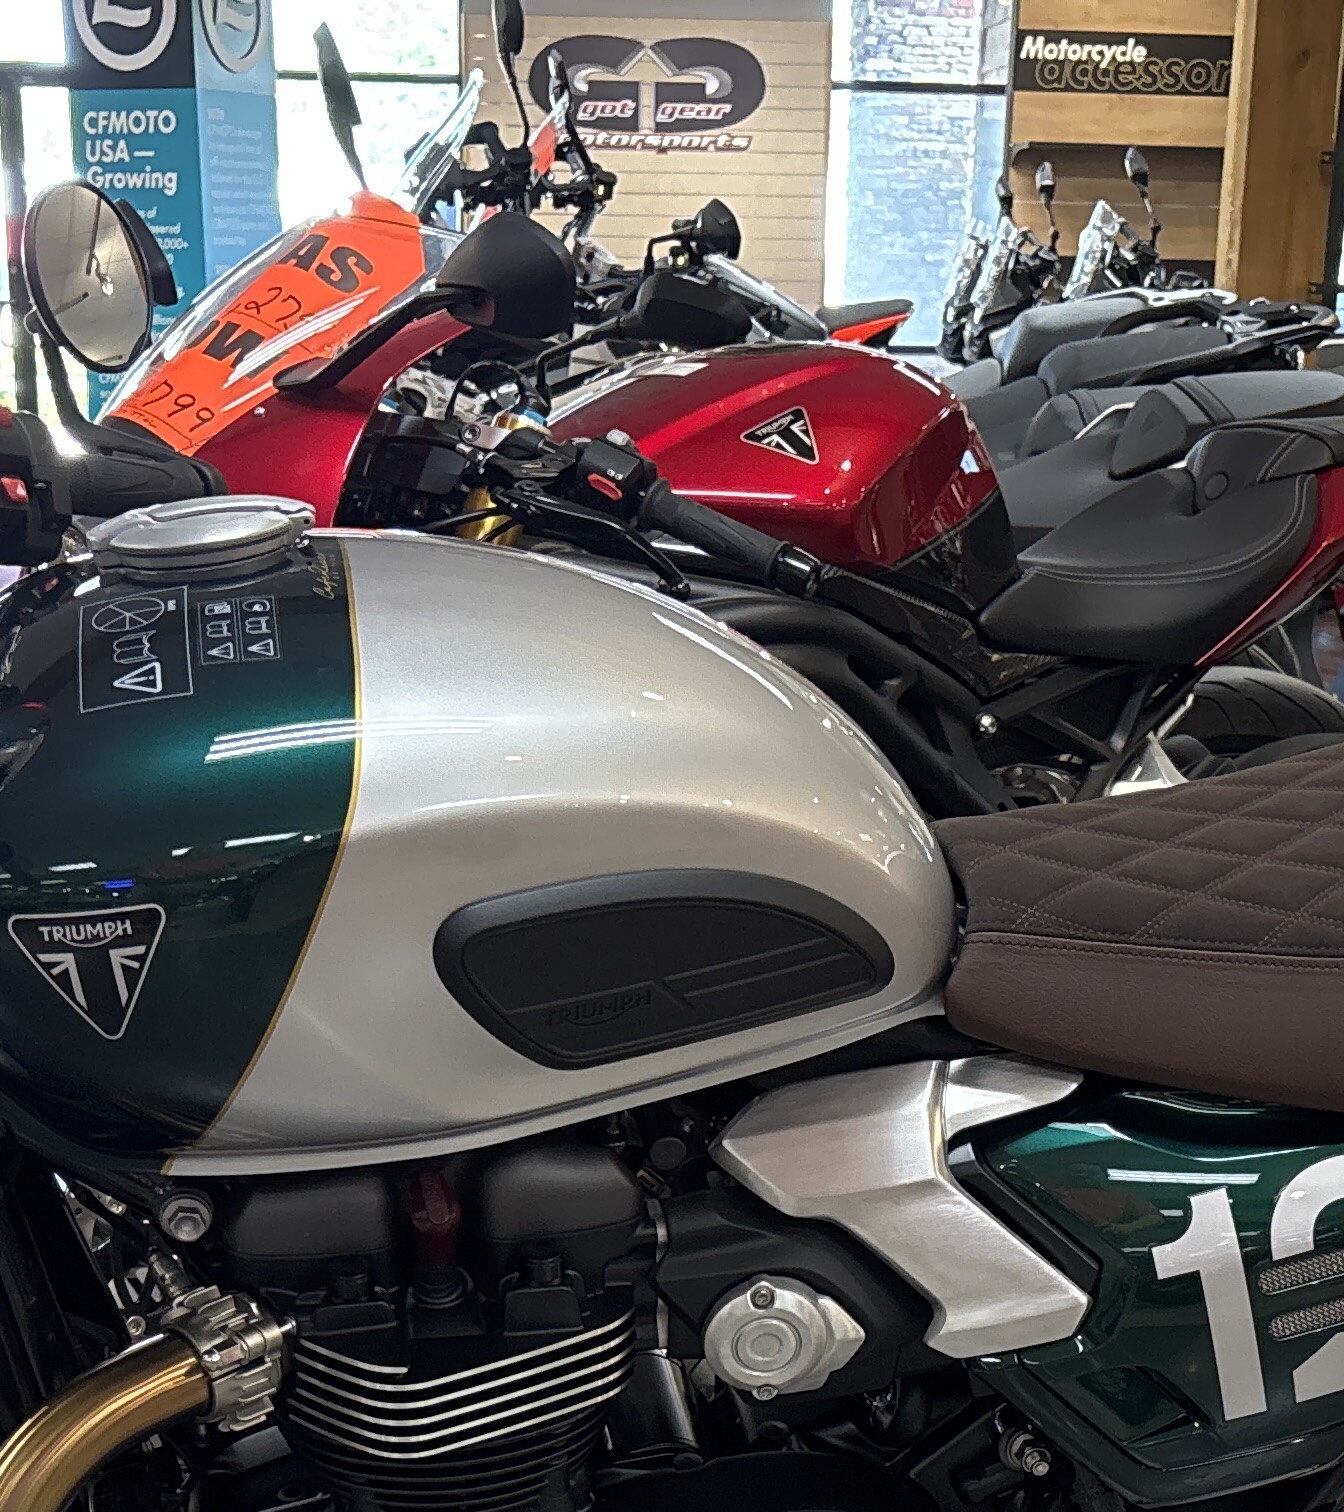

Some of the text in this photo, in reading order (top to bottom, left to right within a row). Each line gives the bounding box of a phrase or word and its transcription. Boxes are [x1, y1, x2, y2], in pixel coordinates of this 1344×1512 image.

[1020, 35, 1147, 68] Motorcycle
[82, 109, 177, 135] CFMOTO
[576, 99, 733, 123] got gear
[85, 139, 130, 163] USA
[558, 131, 752, 151] otorsports
[86, 165, 178, 197] Growing
[755, 414, 796, 437] TRIUMPH
[38, 919, 133, 947] TRIUMPH
[543, 990, 653, 1026] TRIUMPH
